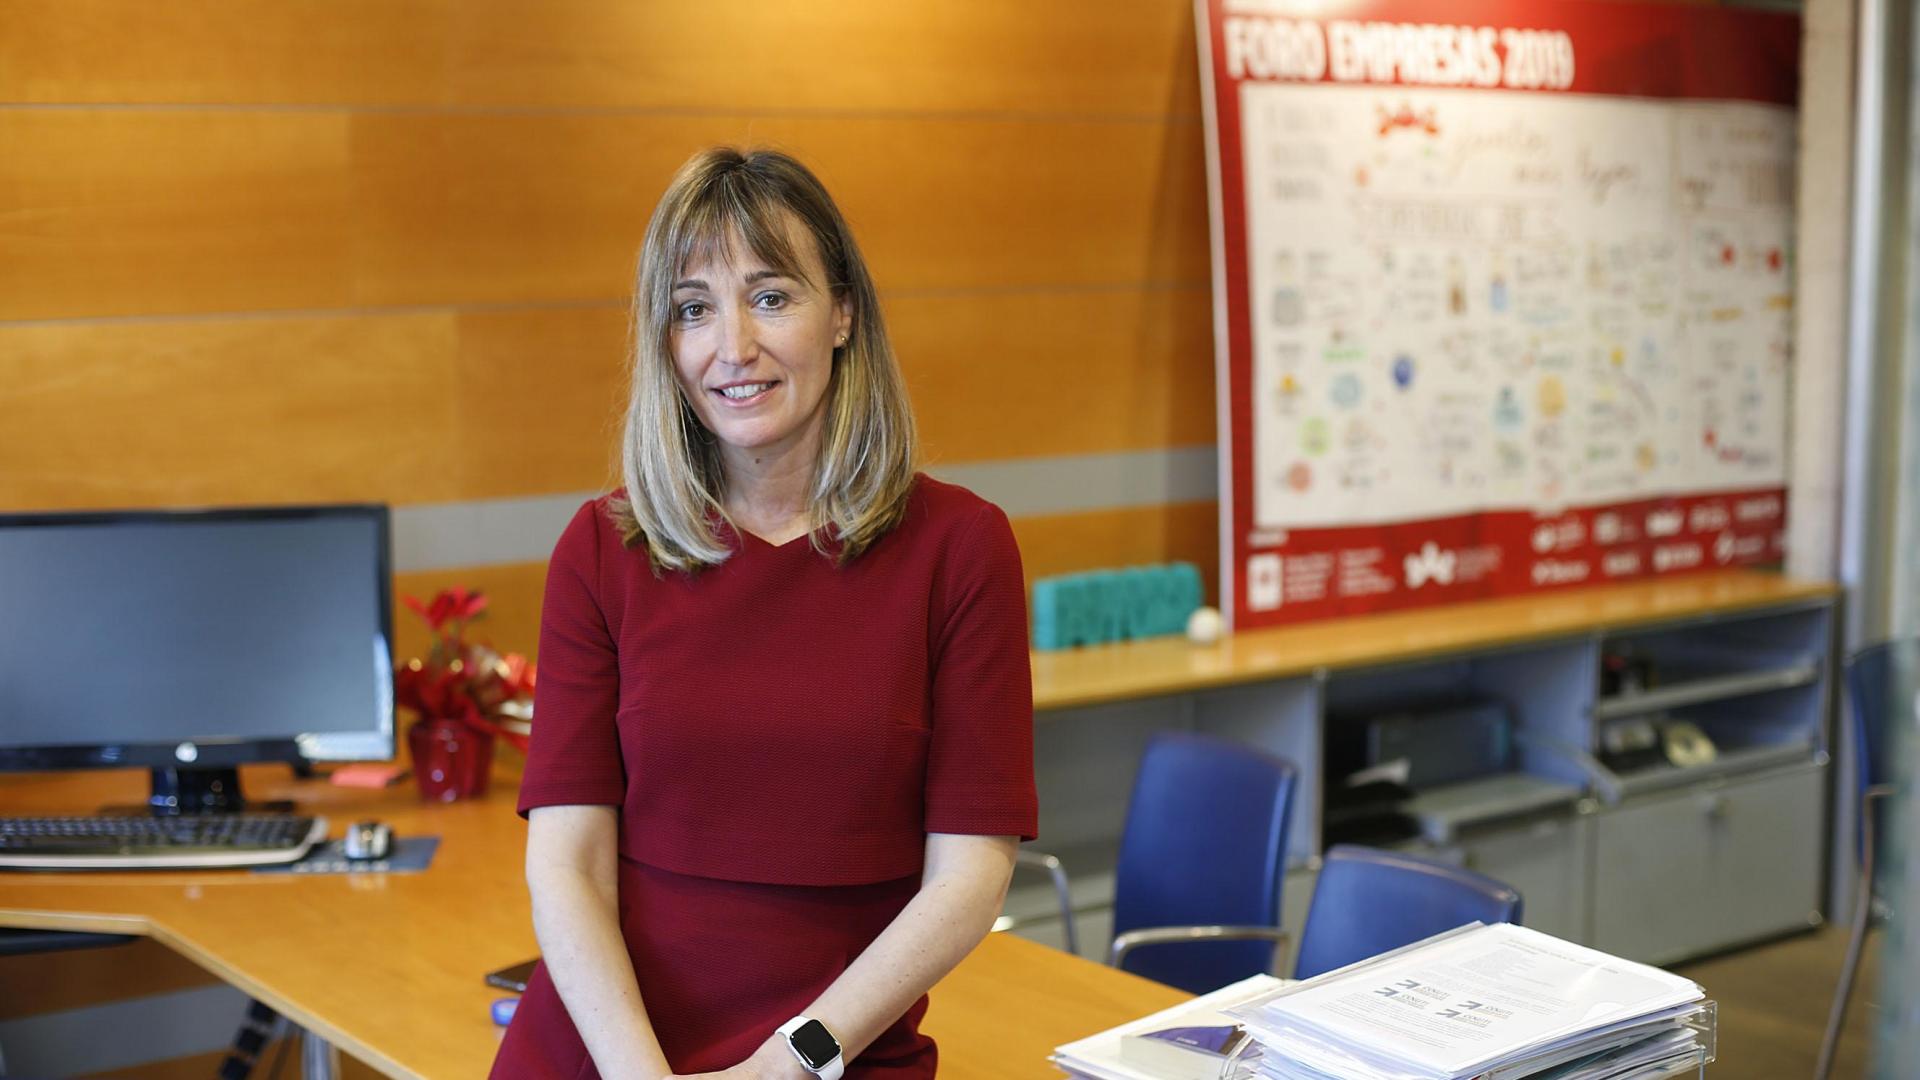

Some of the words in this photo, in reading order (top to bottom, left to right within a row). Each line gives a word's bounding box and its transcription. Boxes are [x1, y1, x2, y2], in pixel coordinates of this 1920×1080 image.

[1225, 18, 1326, 79] FORO
[1330, 21, 1500, 87] EMPRESAS
[1502, 28, 1574, 90] 2019
